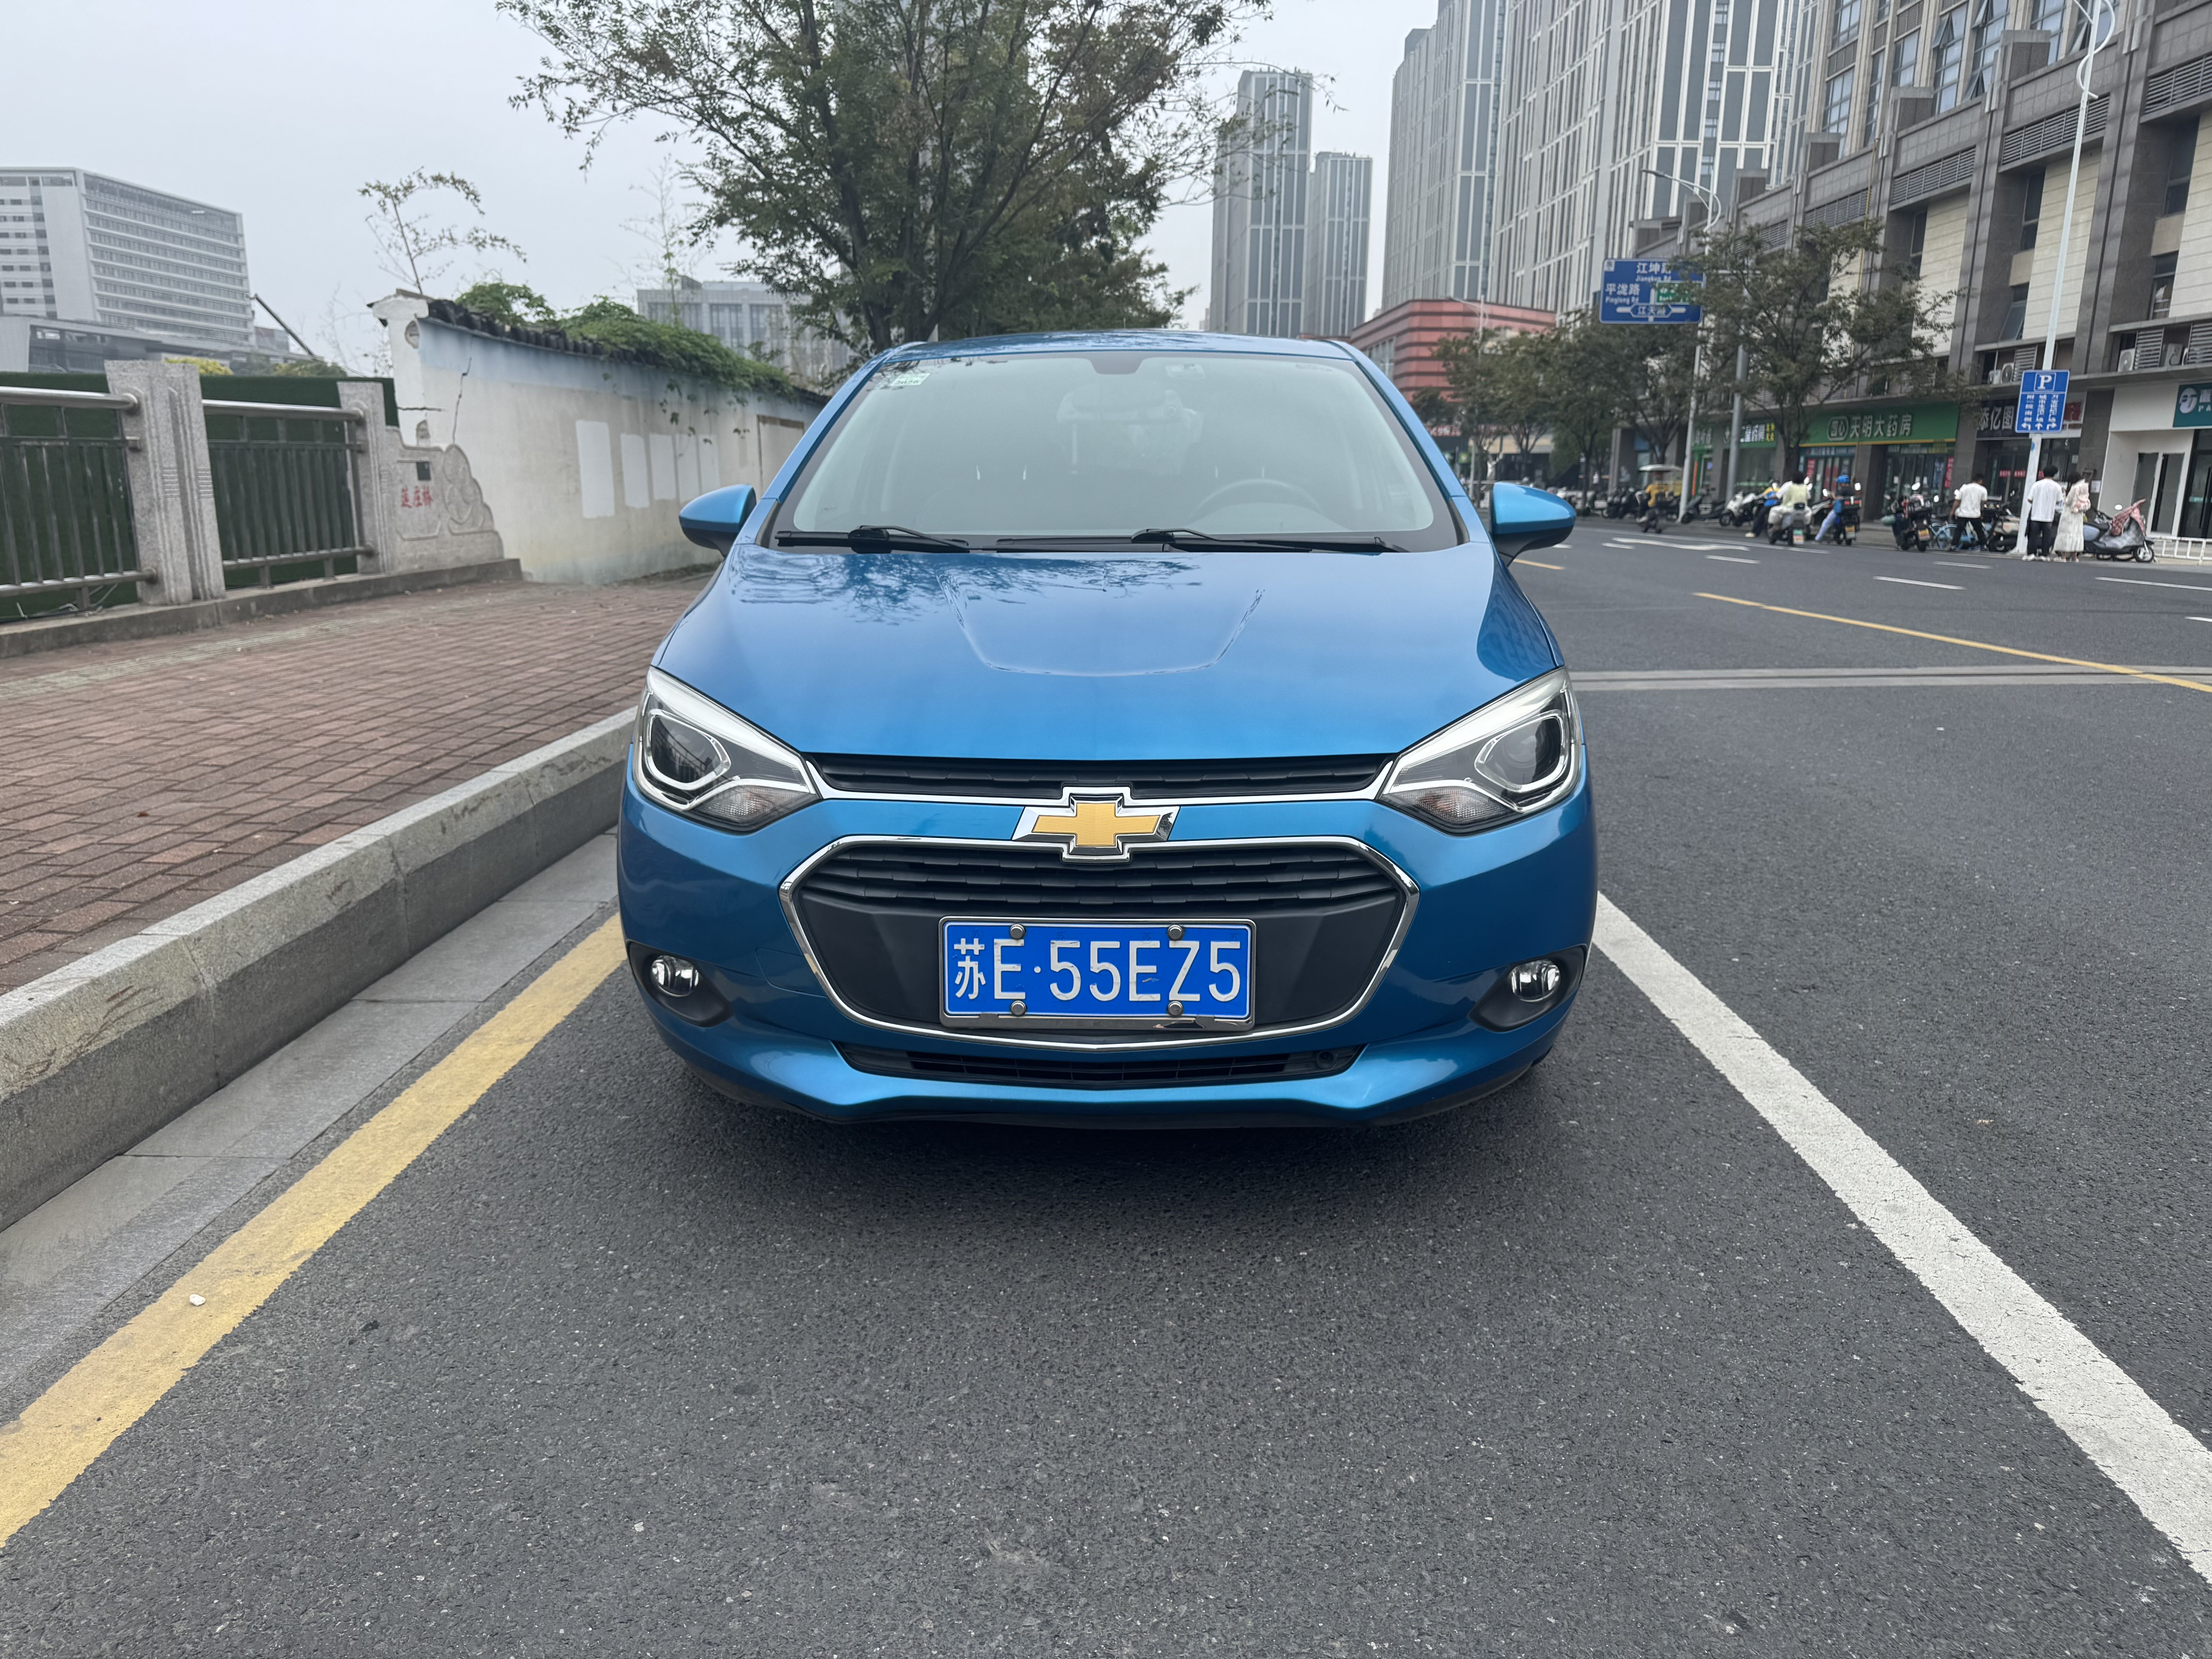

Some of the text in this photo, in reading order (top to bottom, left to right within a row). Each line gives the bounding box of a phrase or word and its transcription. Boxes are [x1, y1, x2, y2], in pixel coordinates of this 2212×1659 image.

[1637, 262, 1671, 274] 江坤路
[1606, 283, 1640, 295] 平泷路
[2037, 375, 2052, 389] P
[1850, 413, 1912, 438] 天明大药房
